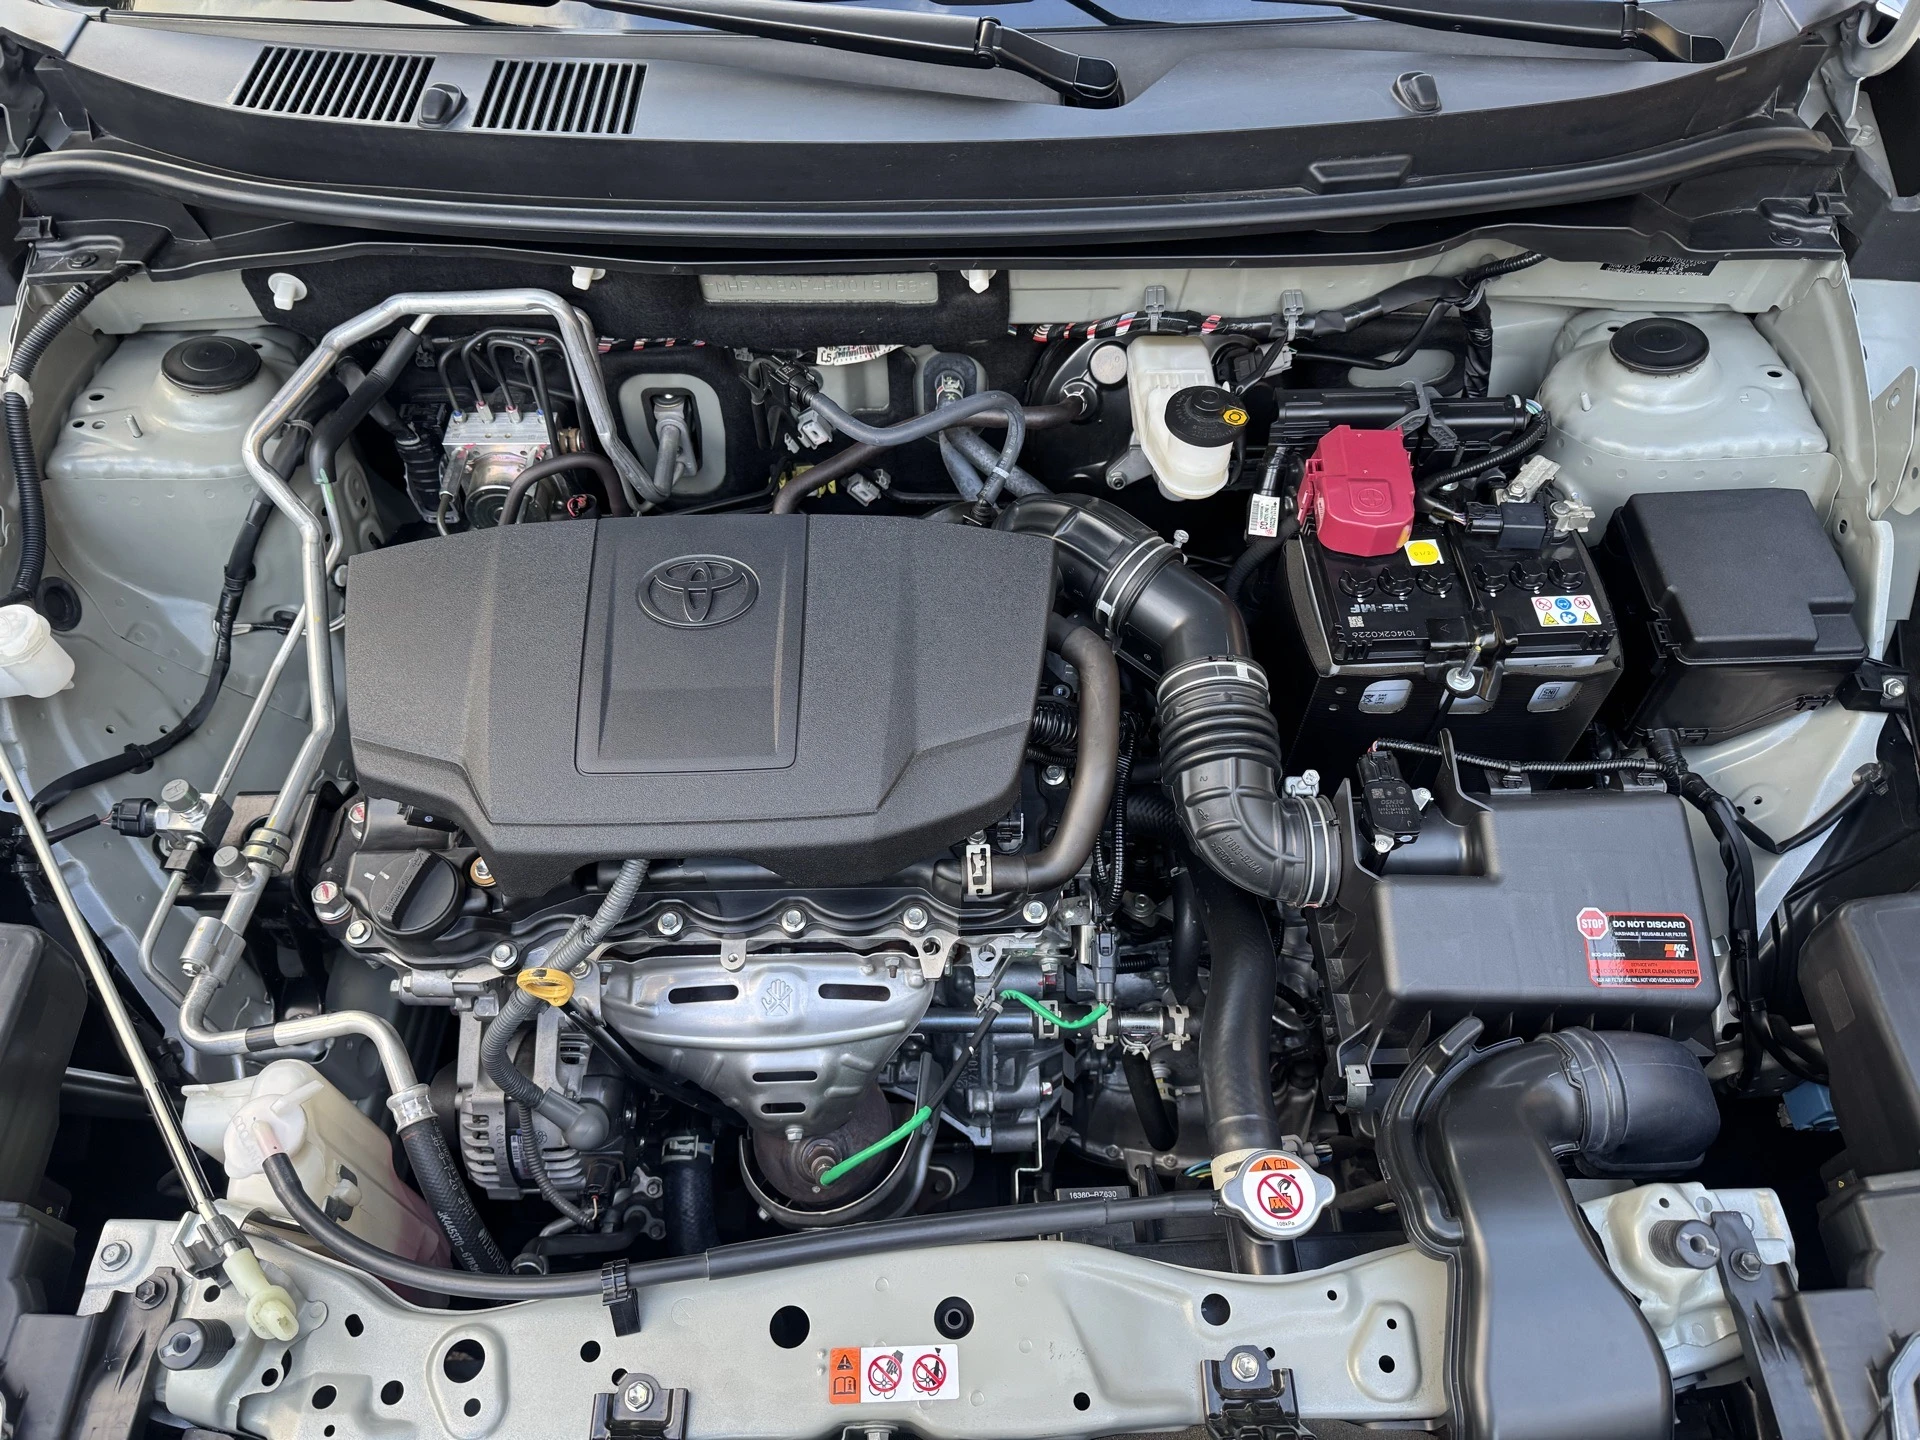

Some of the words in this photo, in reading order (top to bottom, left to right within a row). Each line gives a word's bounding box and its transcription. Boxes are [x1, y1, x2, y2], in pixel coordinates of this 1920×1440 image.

[1351, 630, 1416, 638] 1014C2K0226
[1581, 919, 1604, 929] STOP
[1612, 920, 1626, 928] DO
[1627, 920, 1646, 928] NOT
[1646, 920, 1686, 929] DISCARD
